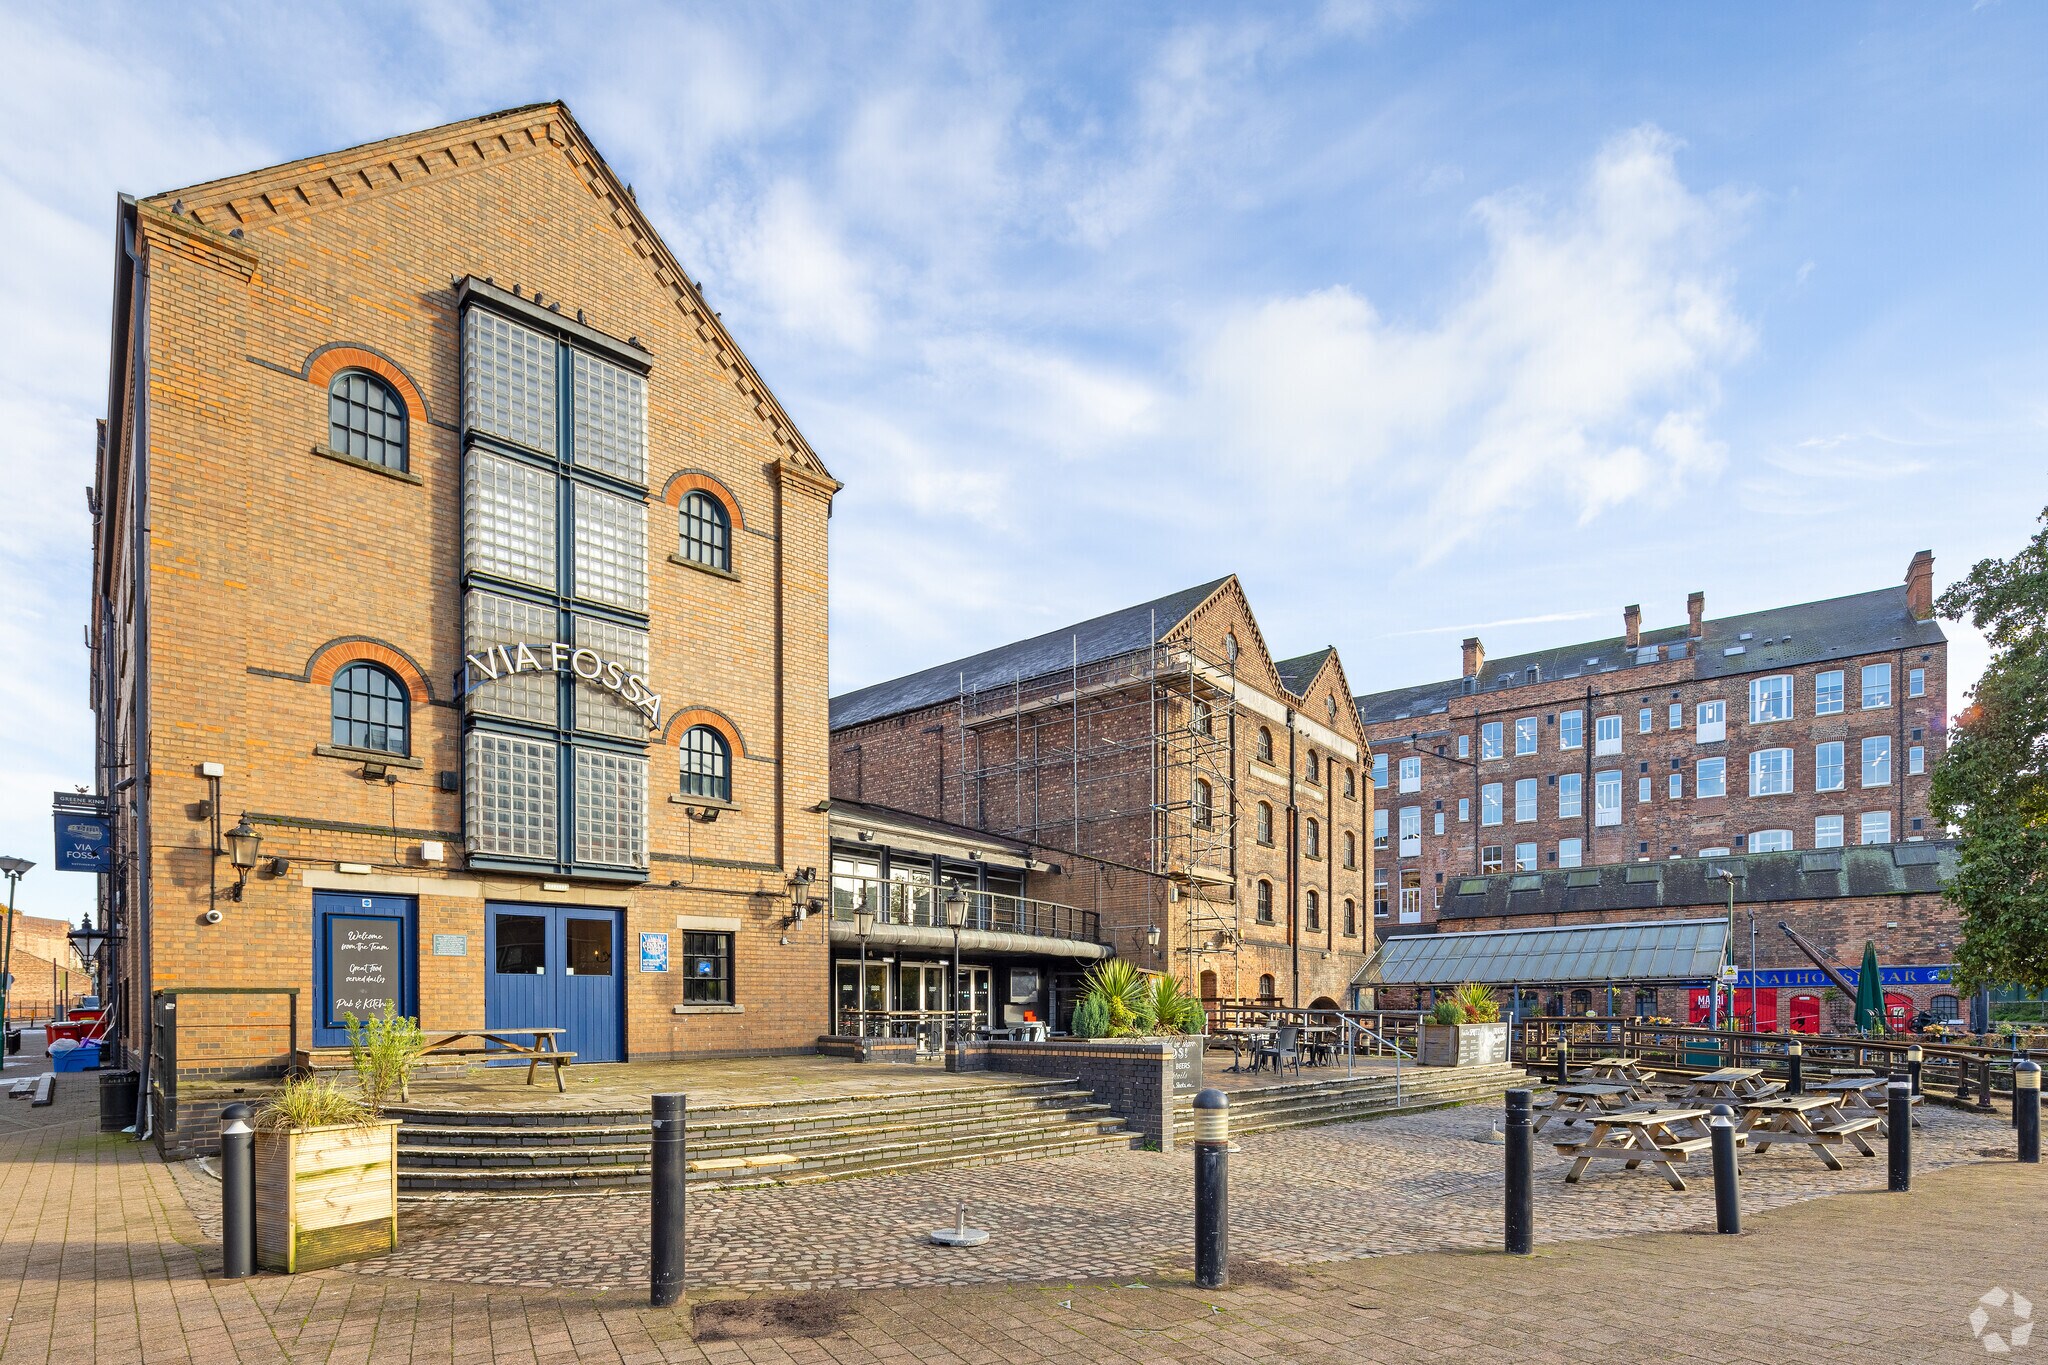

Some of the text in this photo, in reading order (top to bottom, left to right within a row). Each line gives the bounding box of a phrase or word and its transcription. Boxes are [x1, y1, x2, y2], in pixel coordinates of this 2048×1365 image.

[467, 641, 661, 720] VIA FOSSA
[60, 796, 85, 804] GREENE
[74, 843, 92, 851] VIA
[66, 851, 100, 860] FOSSA
[347, 930, 383, 941] Welcome
[350, 963, 371, 974] Great
[366, 975, 385, 984] daily
[1739, 972, 1860, 985] ANALHOS
[336, 998, 395, 1009] Pub & Kitch
[1698, 994, 1724, 1005] MARÍ
